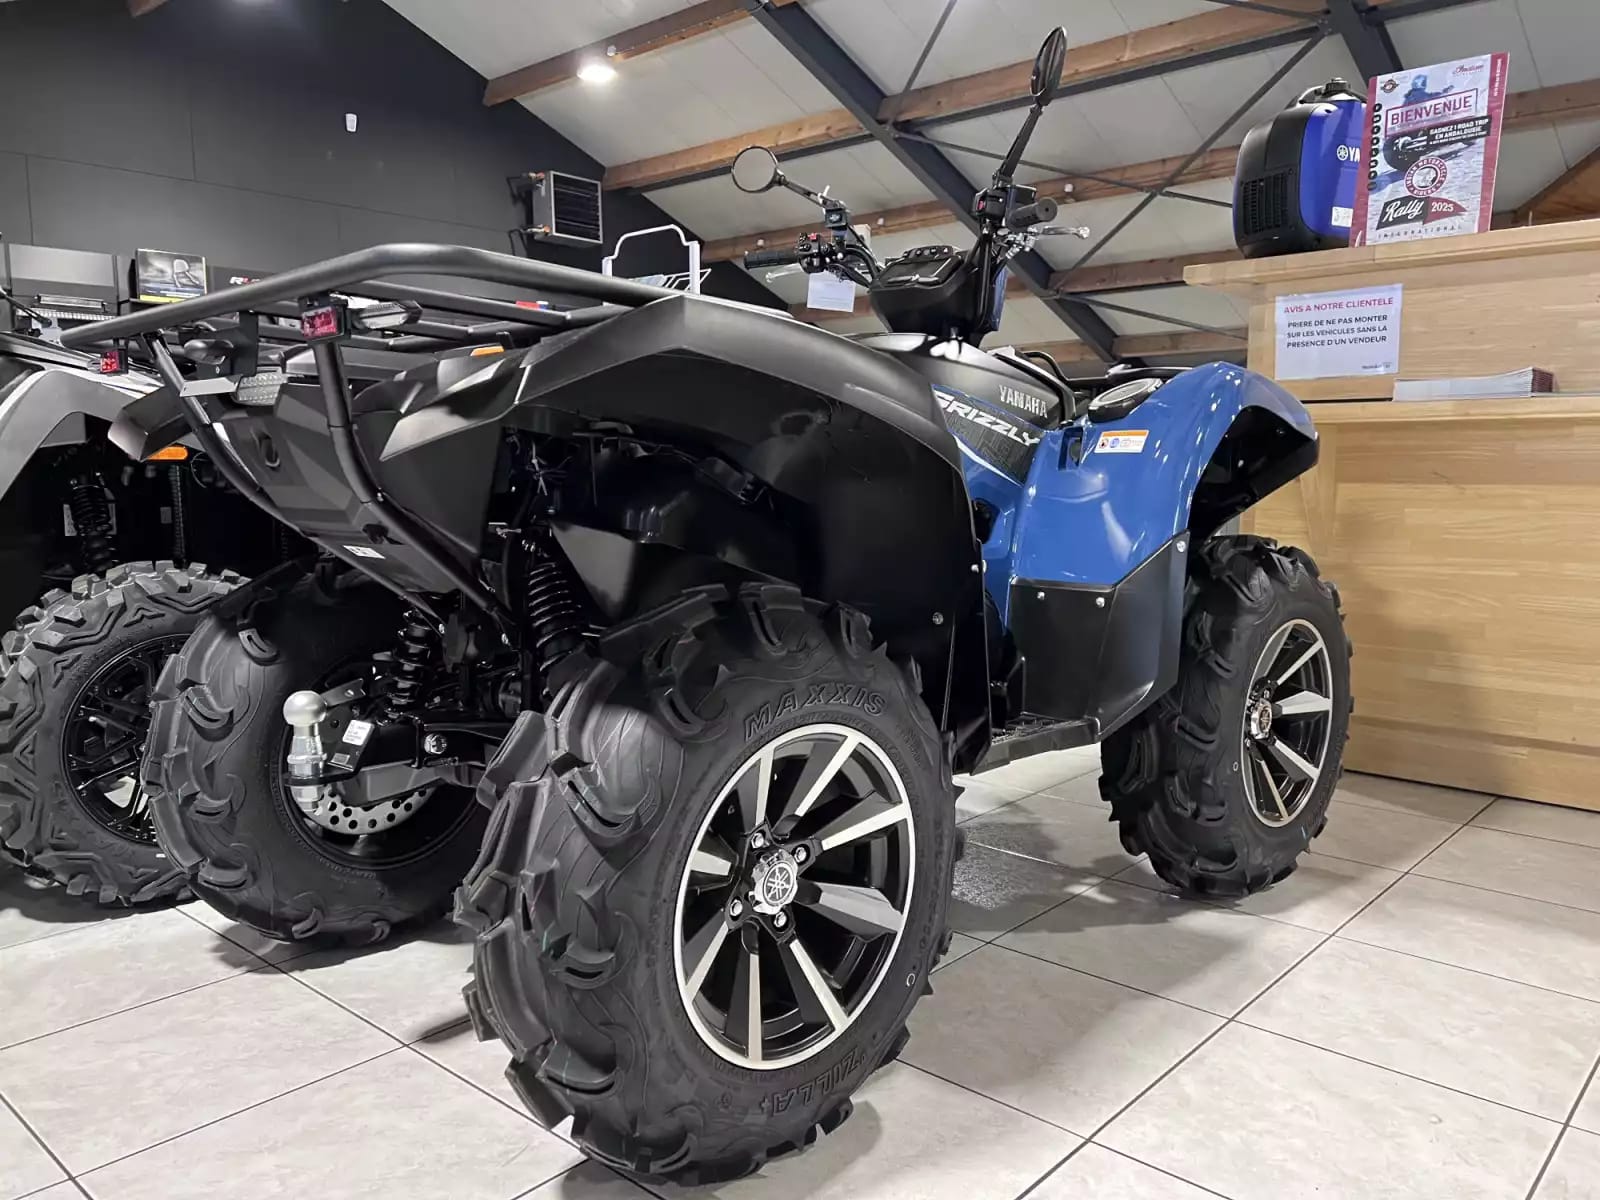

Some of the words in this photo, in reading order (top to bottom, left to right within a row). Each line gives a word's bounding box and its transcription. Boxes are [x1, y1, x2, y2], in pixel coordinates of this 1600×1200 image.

[1391, 95, 1472, 125] BIENVENUE
[1475, 118, 1489, 126] TRIP
[1382, 199, 1424, 222] Rally
[1431, 202, 1454, 213] 2025
[1314, 302, 1344, 310] NOTRE
[1346, 297, 1393, 308] CLIENTELE
[1288, 320, 1312, 328] PRIERE
[1355, 314, 1388, 323] MONTER
[1316, 327, 1355, 336] VEHICULES
[1356, 325, 1377, 333] SANS
[1287, 339, 1325, 348] PRESENCE
[1348, 335, 1387, 344] VENDEUR
[999, 384, 1048, 419] YAMAHA
[744, 682, 887, 742] MAXXIS
